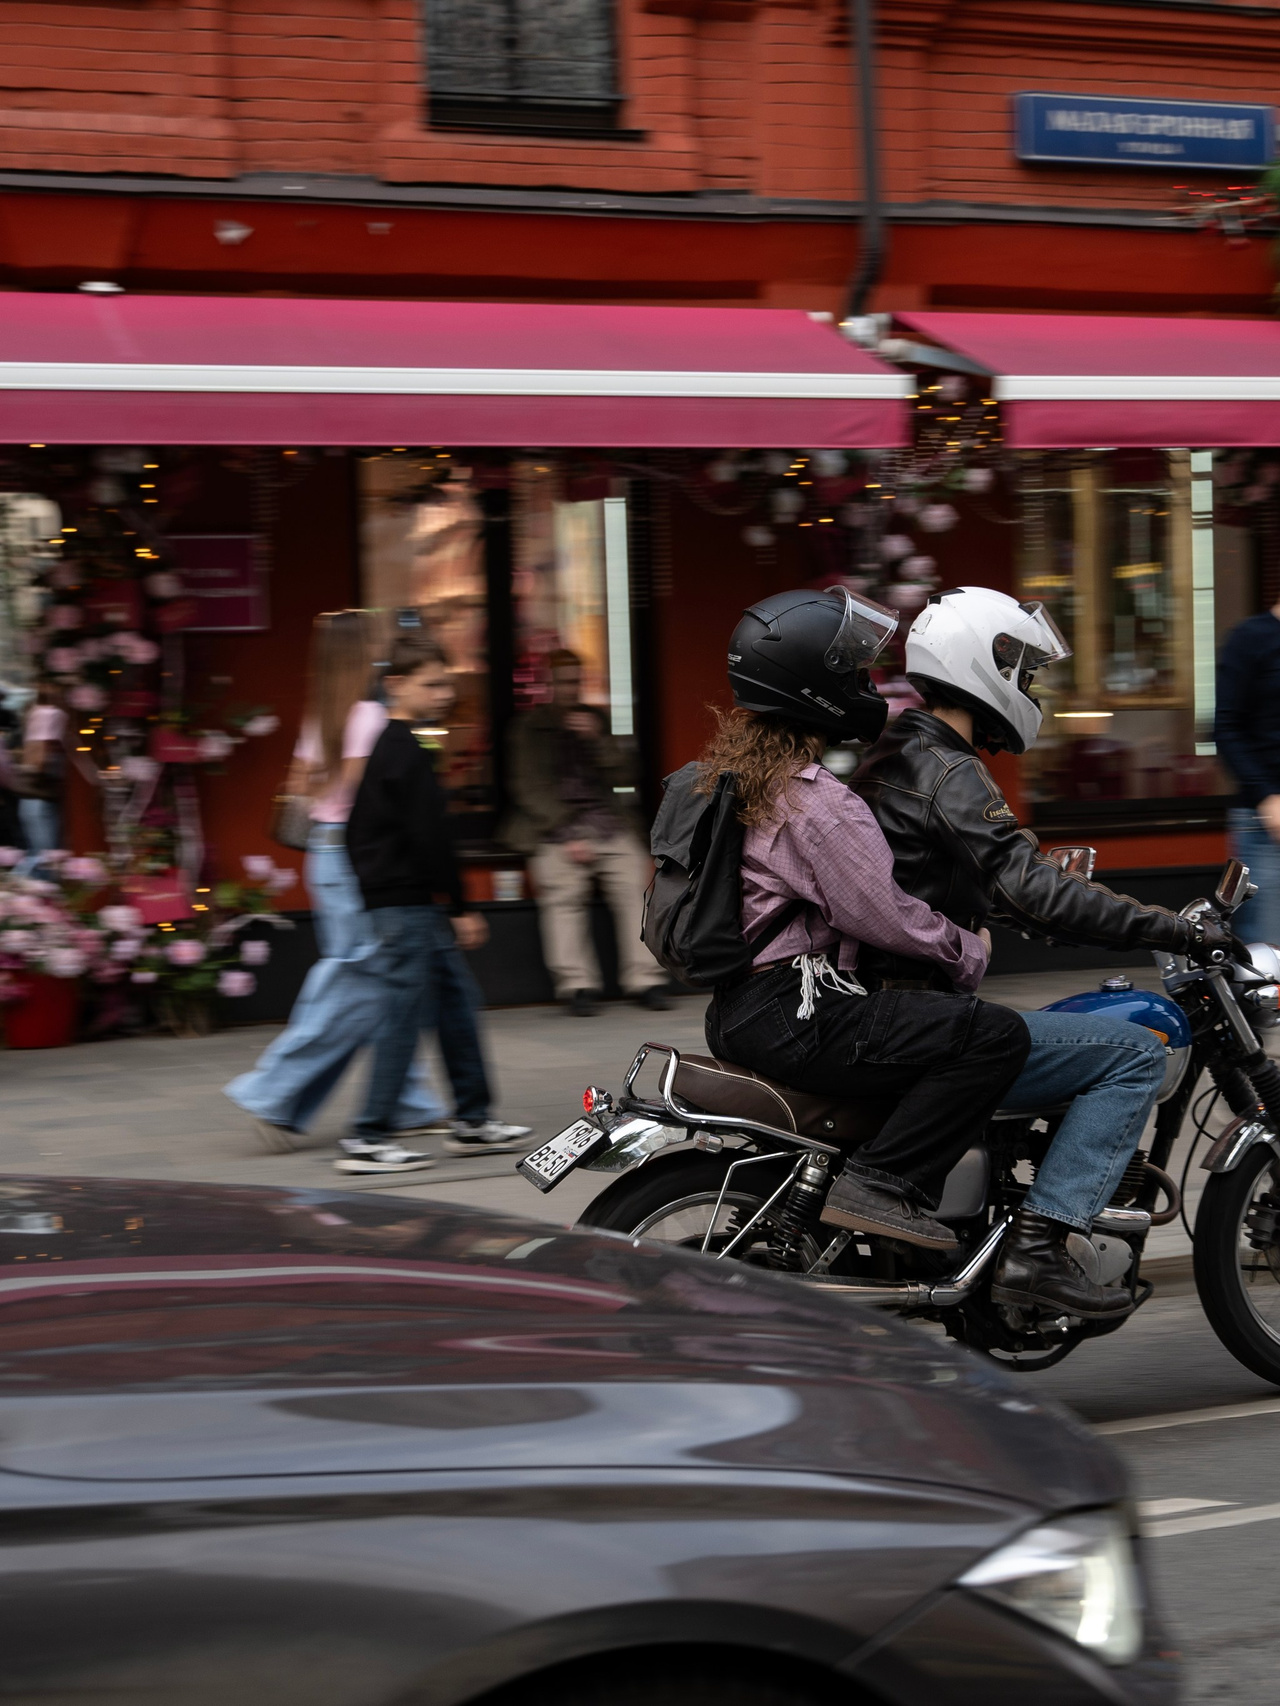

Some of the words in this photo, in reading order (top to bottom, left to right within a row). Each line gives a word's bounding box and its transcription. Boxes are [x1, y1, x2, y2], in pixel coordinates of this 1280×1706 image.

[800, 687, 846, 717] LS2
[565, 1124, 598, 1149] 1906
[543, 1154, 569, 1177] 50
